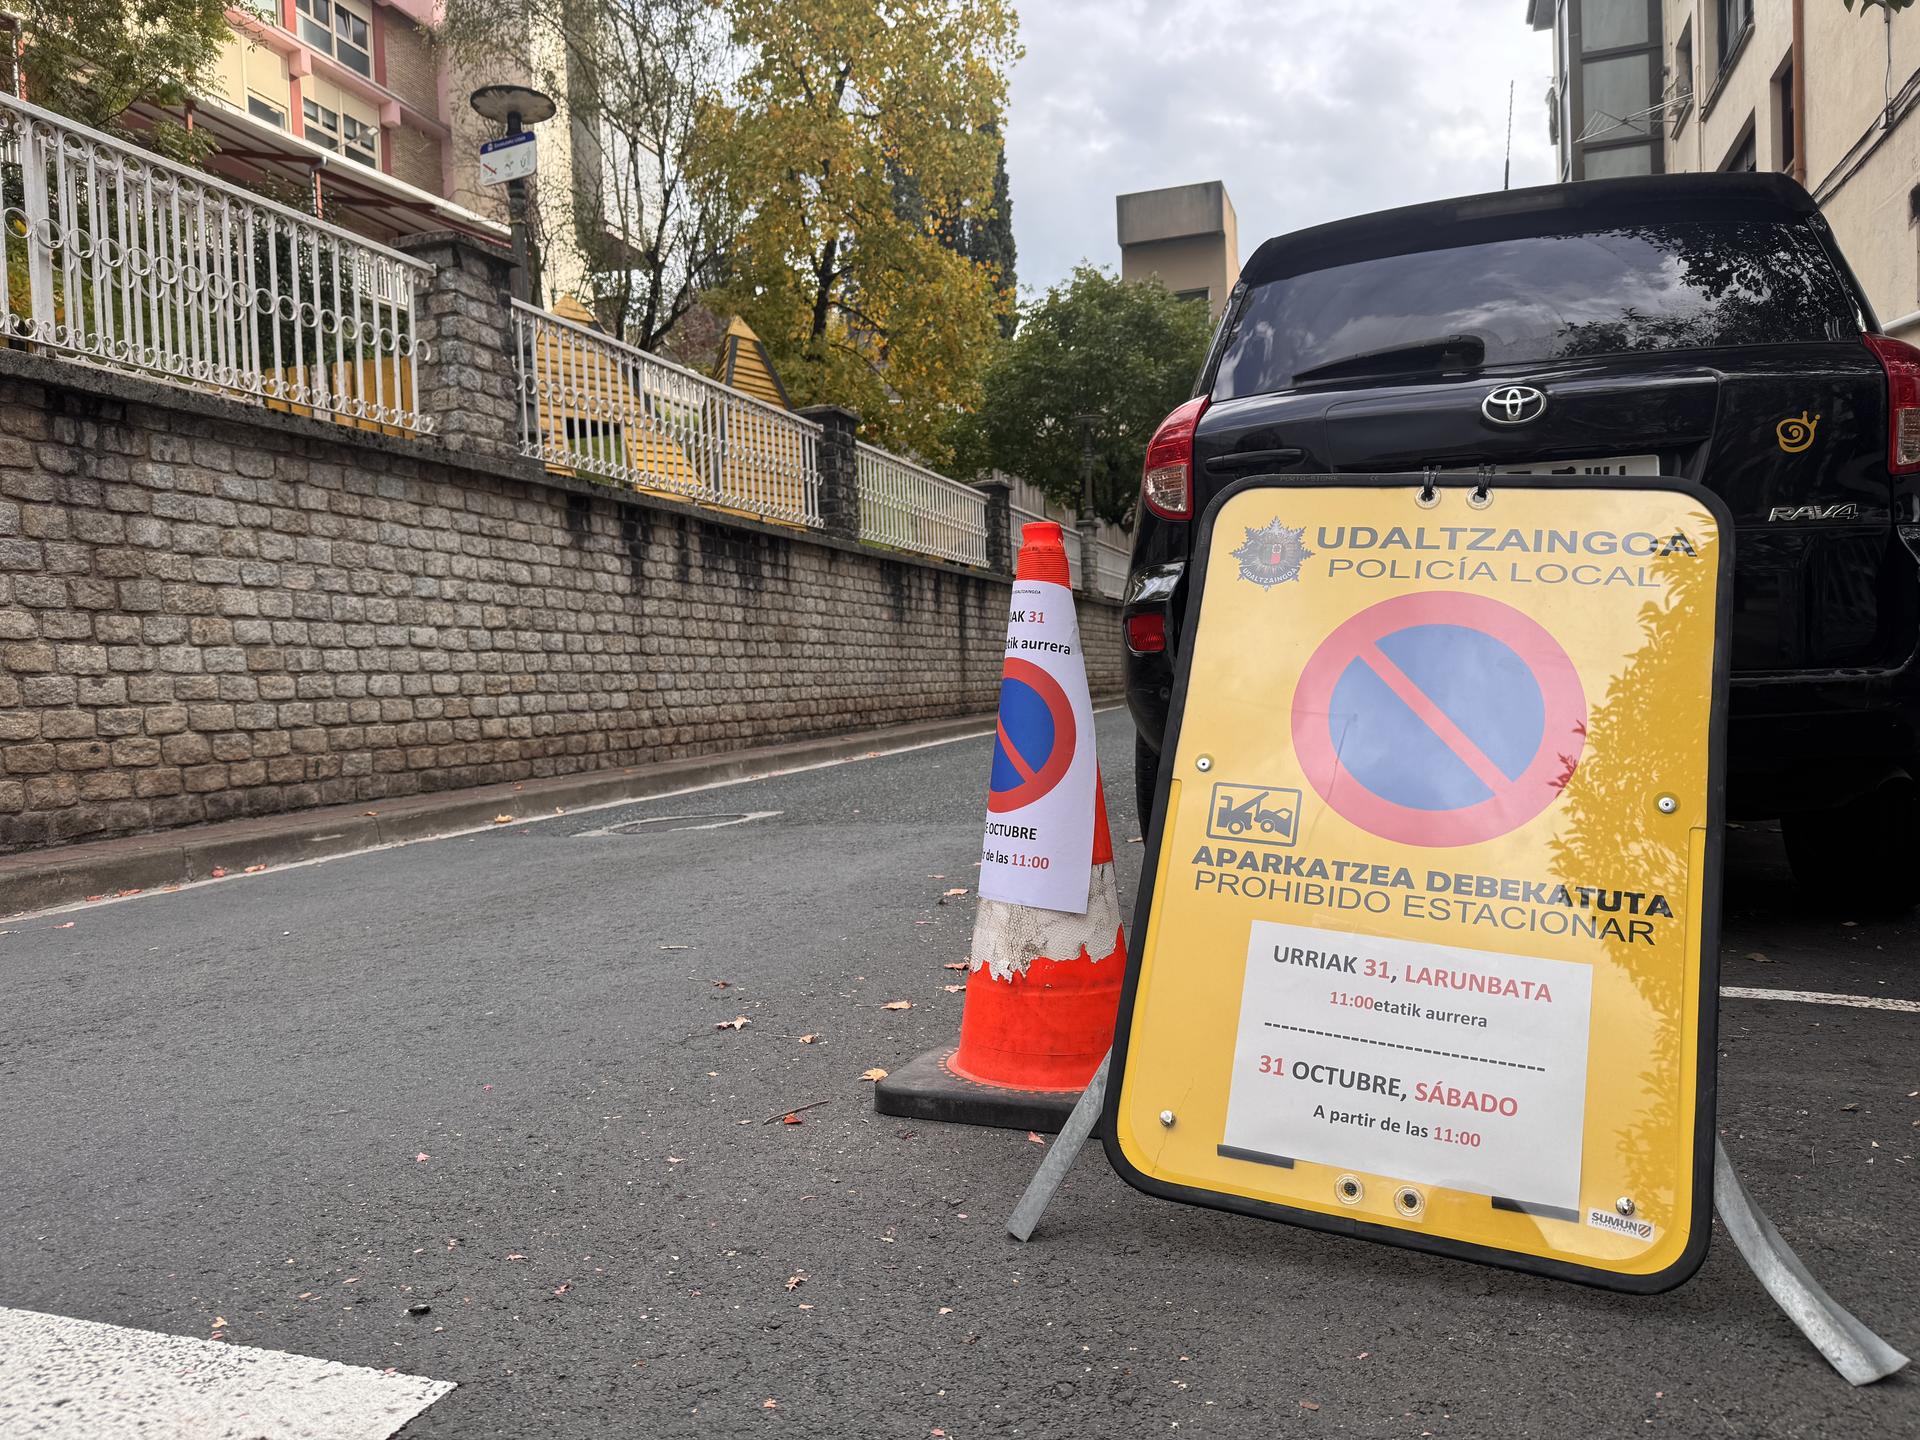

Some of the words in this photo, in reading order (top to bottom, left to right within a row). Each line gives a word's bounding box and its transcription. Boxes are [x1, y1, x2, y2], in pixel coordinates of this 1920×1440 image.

[1768, 503, 1858, 521] RAV4
[1317, 526, 1697, 557] UDALTZAINGOA
[1242, 567, 1298, 584] UDALTZAINGOA
[1328, 556, 1498, 581] POLICÍA
[1510, 561, 1661, 587] LOCAL
[1028, 611, 1045, 624] 31
[1021, 639, 1071, 655] aurrera
[989, 823, 1038, 840] OCTUBRE
[986, 849, 994, 862] de
[996, 850, 1009, 864] las
[1012, 853, 1050, 870] 11:00
[1192, 845, 1415, 889] APARKATZEA
[1426, 870, 1674, 918] DEBEKATUTA
[1195, 870, 1391, 913] PROHIBIDO
[1403, 894, 1656, 945] ESTACIONAR
[1273, 945, 1358, 974] URRIAK
[1363, 958, 1398, 984] 31,
[1405, 965, 1553, 1003] LARUNBATA
[1425, 1008, 1488, 1028] aurrera
[1258, 1054, 1285, 1076] 31
[1292, 1061, 1407, 1102] OCTUBRE,
[1415, 1081, 1519, 1117] SÁBADO
[1313, 1104, 1326, 1119] A
[1329, 1106, 1376, 1129] partir
[1380, 1116, 1401, 1133] de
[1406, 1121, 1429, 1138] las
[1433, 1126, 1482, 1148] 11:00
[1591, 1212, 1637, 1232] SUMUN
